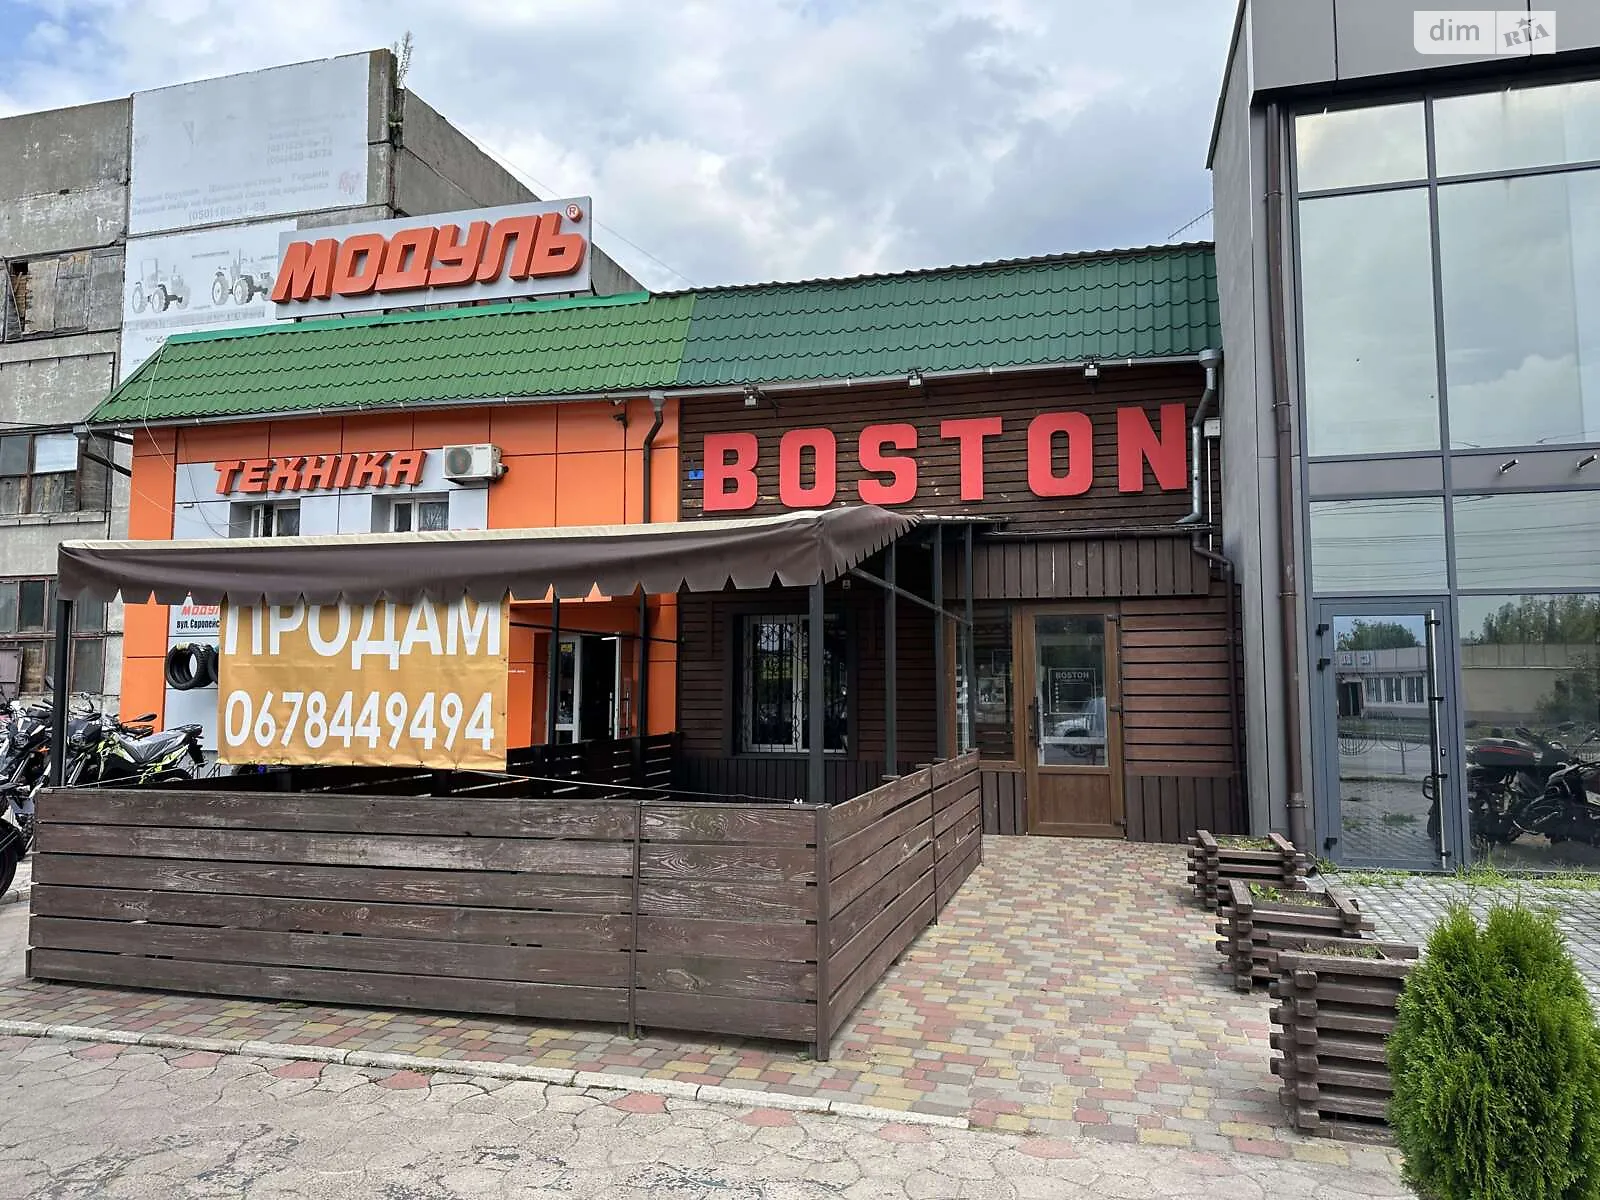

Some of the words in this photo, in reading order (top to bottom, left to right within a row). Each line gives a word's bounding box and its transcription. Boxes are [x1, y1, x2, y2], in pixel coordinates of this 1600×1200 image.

[271, 211, 587, 303] МОДУЛЬ
[214, 450, 427, 495] ТЕХНІКА
[703, 404, 1188, 511] BOSTON
[224, 596, 501, 670] ПРОДАМ
[1055, 671, 1089, 679] BOSTON
[224, 690, 495, 751] 0678449494
